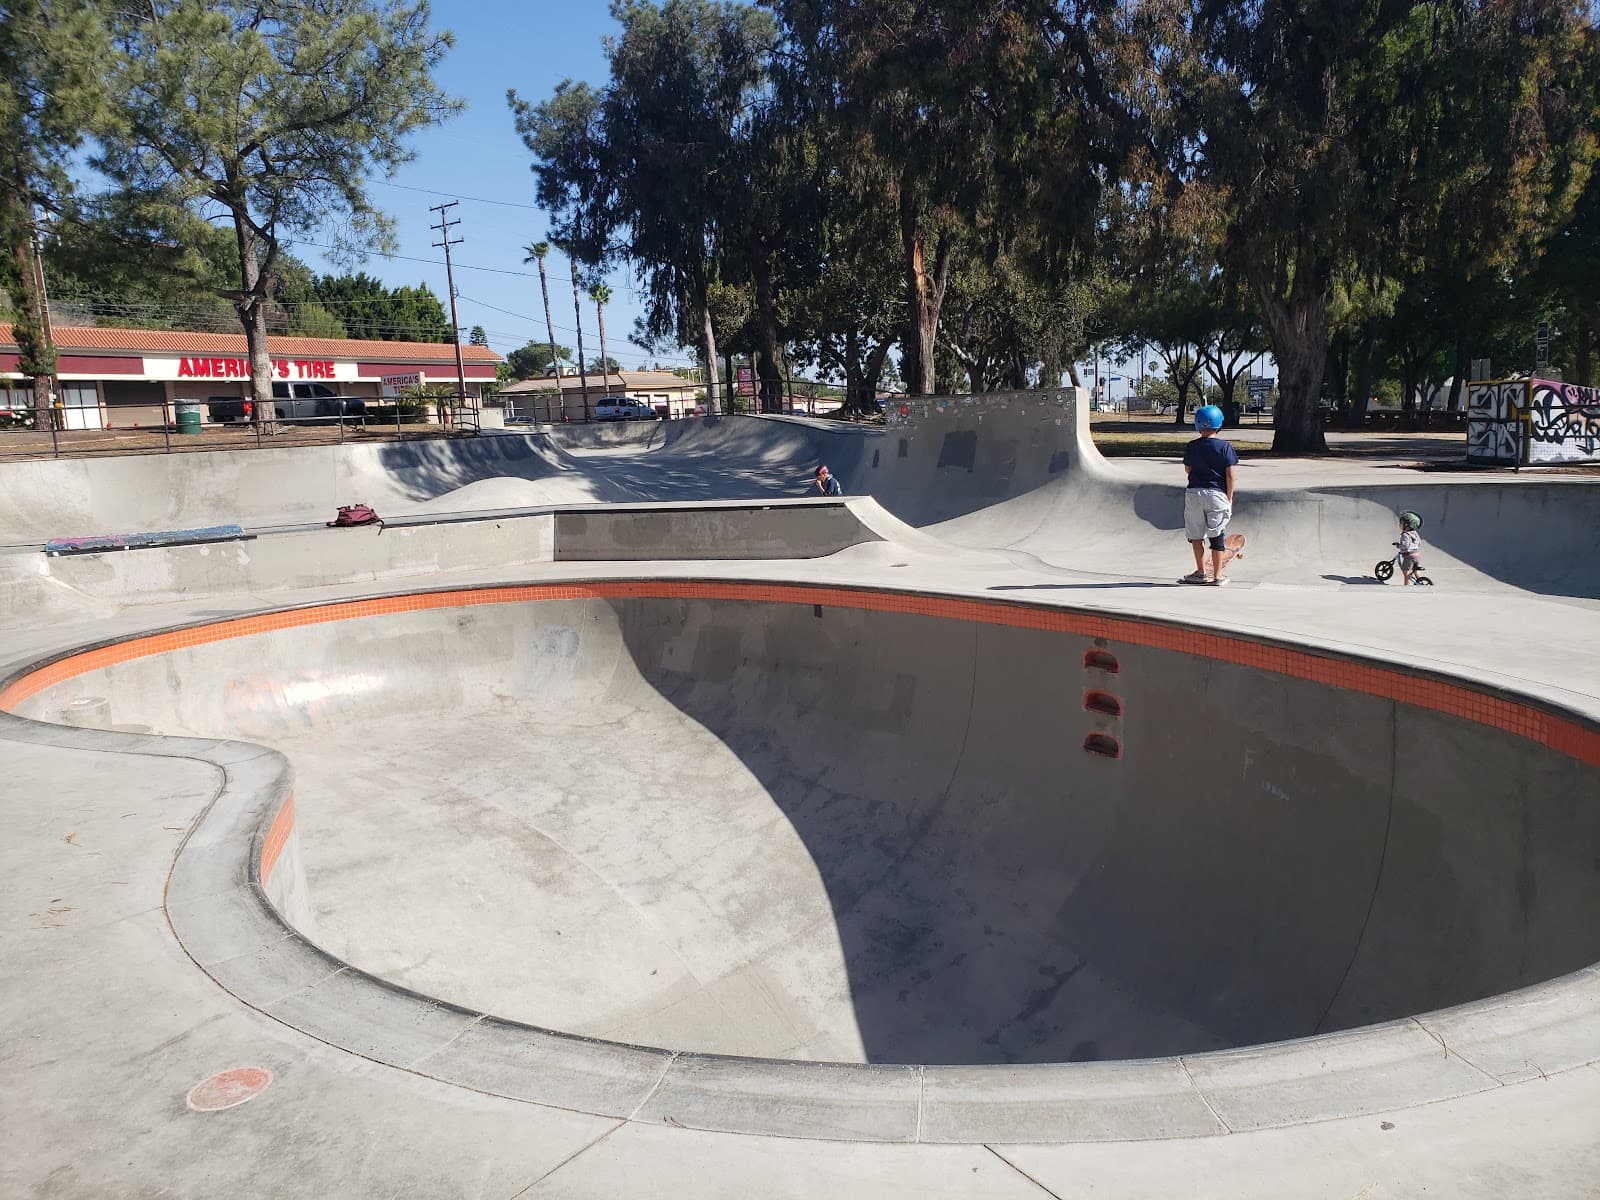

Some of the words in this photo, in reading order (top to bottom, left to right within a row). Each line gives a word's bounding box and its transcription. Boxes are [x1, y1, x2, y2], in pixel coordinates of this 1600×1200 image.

[178, 357, 290, 379] AMERI'S
[294, 360, 336, 379] TIRE
[383, 375, 419, 385] AMERICA'S
